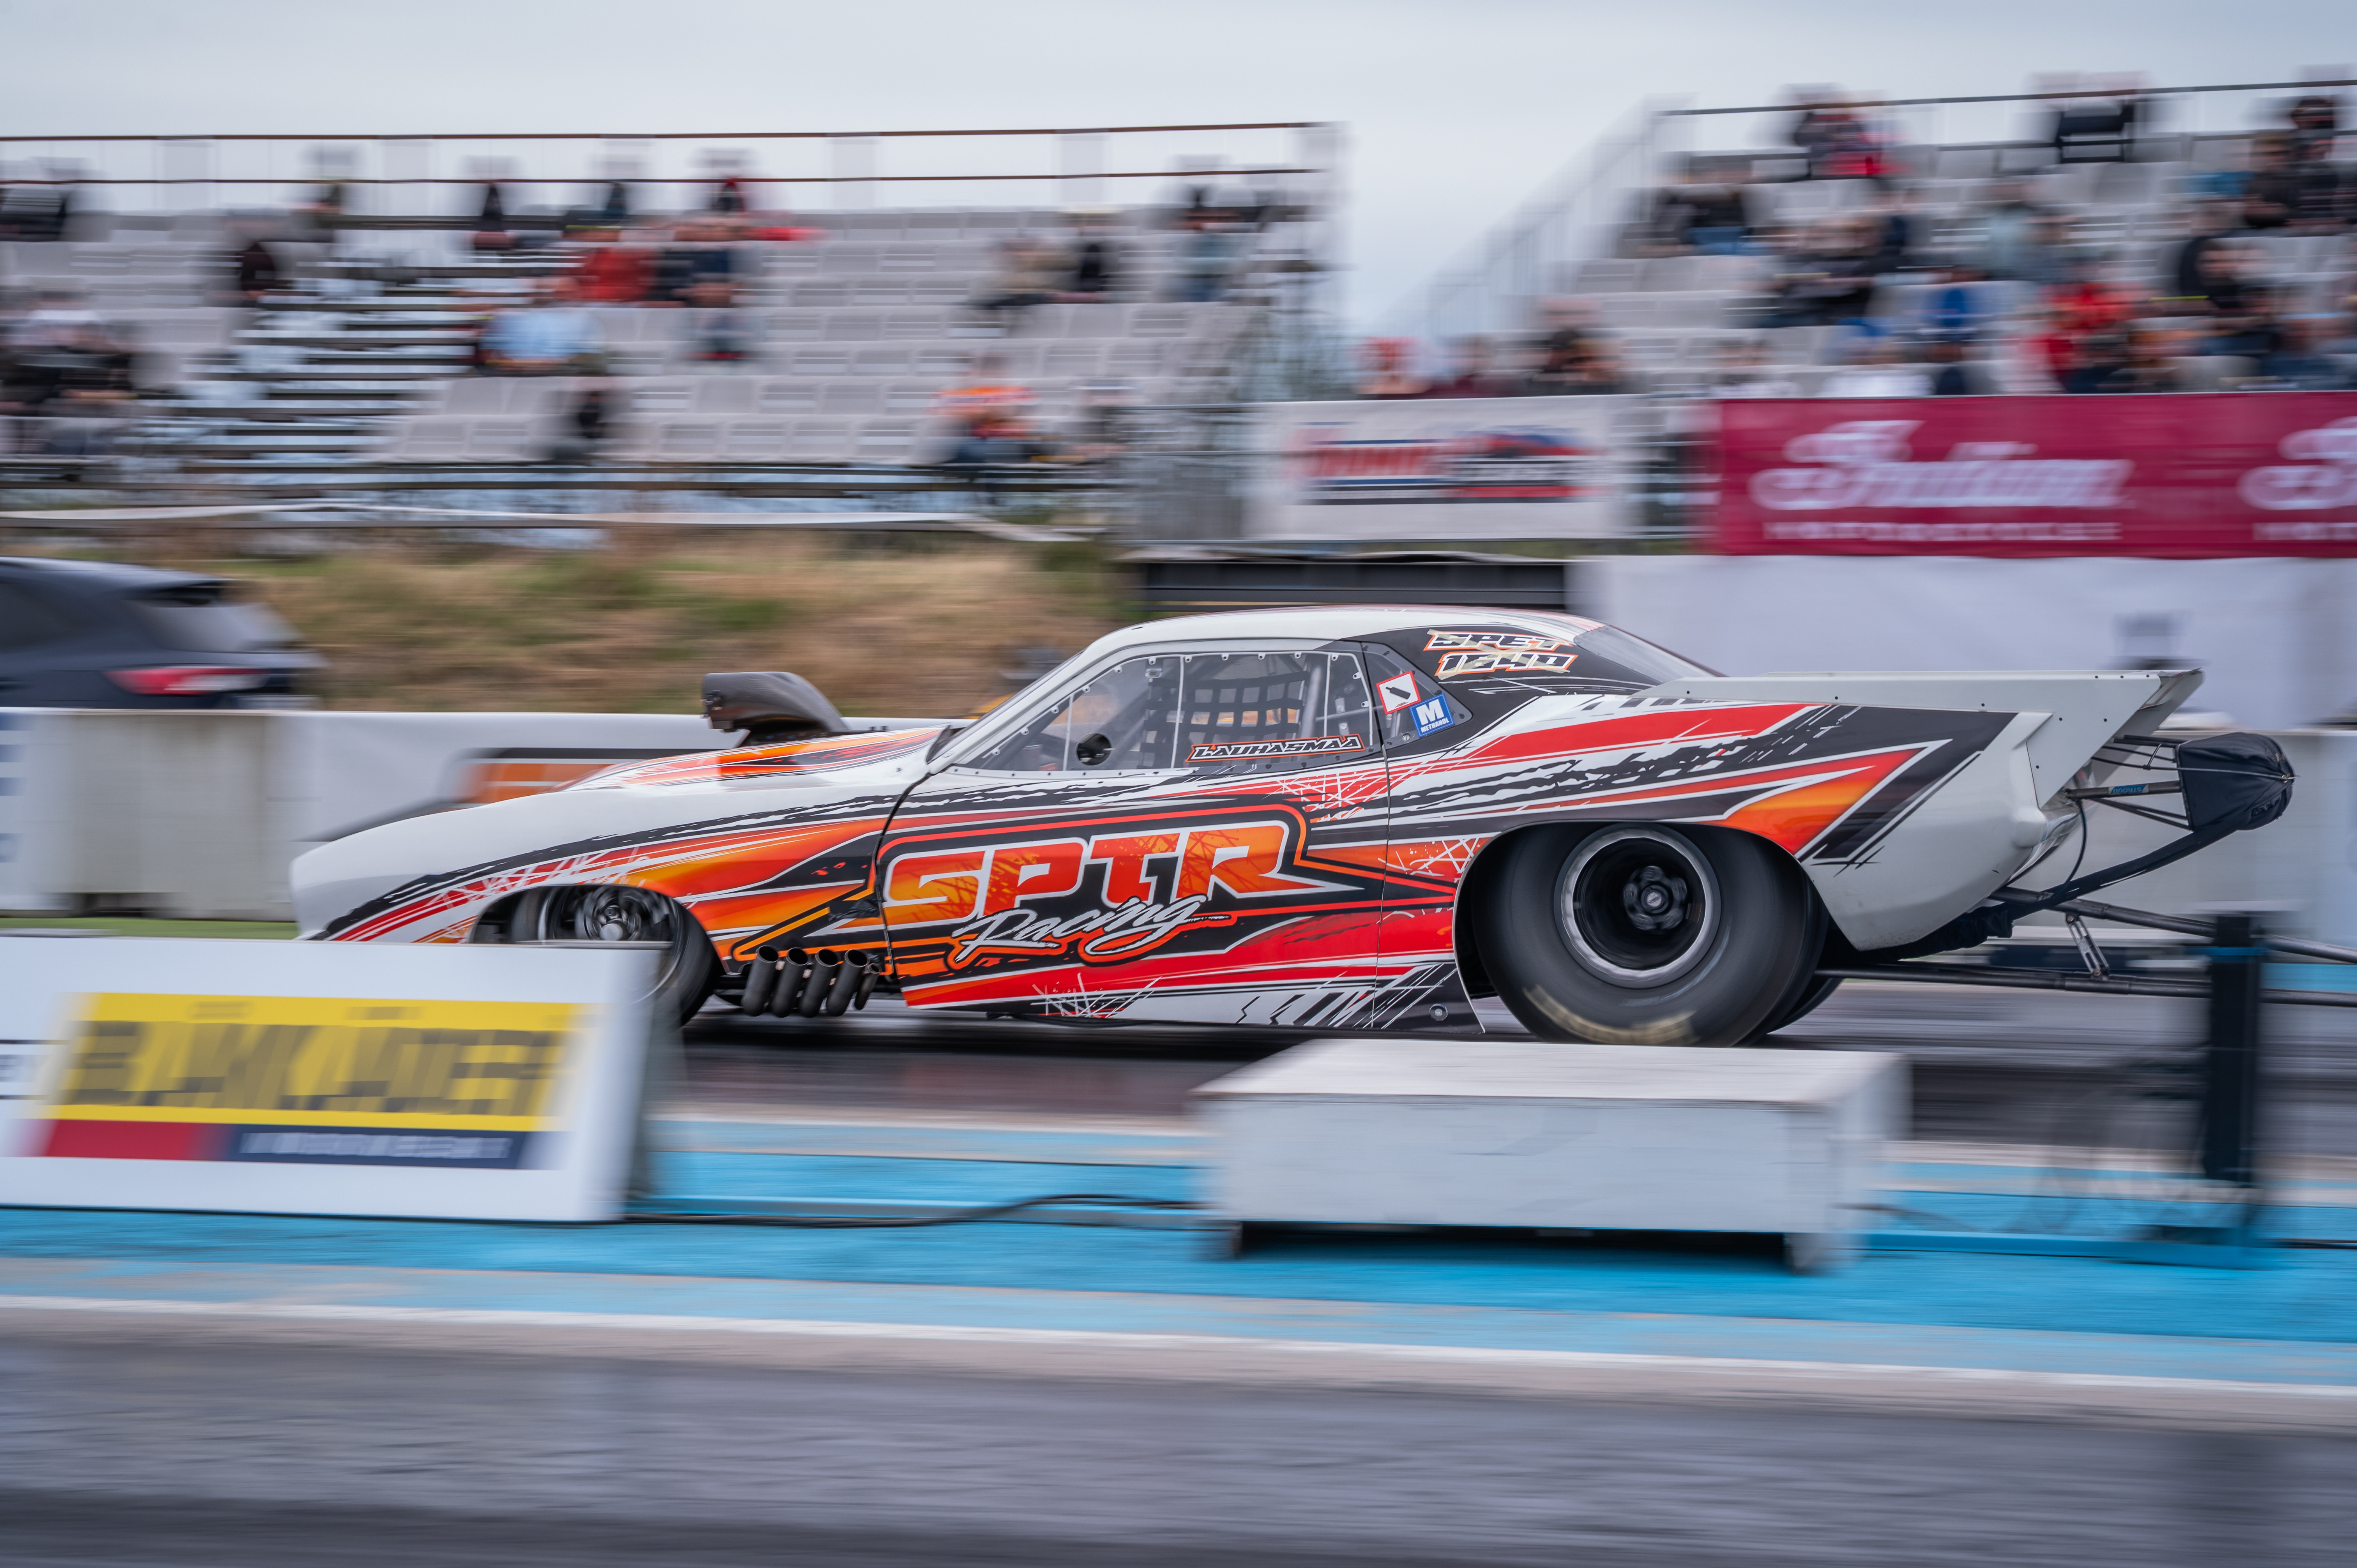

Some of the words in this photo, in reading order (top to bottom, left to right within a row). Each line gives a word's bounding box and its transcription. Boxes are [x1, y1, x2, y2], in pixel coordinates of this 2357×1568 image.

[1416, 699, 1444, 726] M
[1421, 717, 1449, 733] METHANOL
[1191, 736, 1362, 760] LAUHASMAA
[805, 820, 1365, 937] SPTR
[952, 895, 1232, 962] Racing
